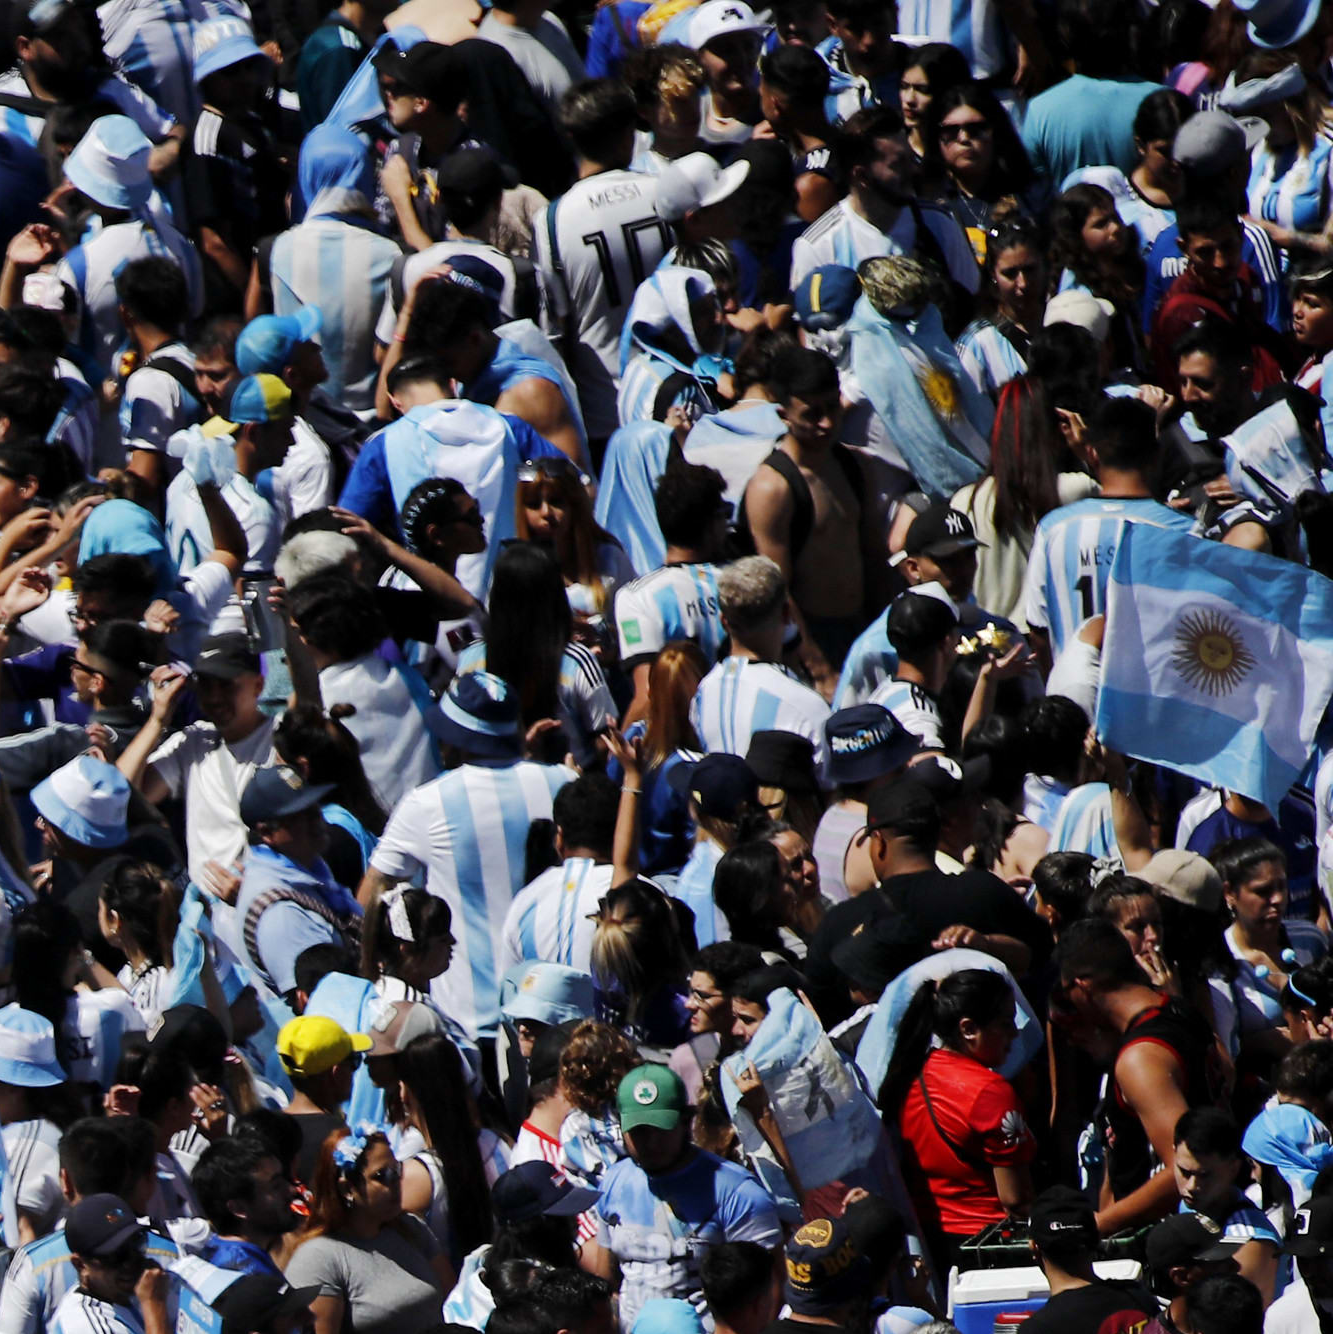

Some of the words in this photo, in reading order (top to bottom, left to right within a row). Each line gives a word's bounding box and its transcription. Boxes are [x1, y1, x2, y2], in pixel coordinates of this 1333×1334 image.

[589, 184, 642, 210] MESSI
[1080, 546, 1116, 567] MES
[686, 596, 720, 617] MES
[1073, 576, 1094, 620] 1
